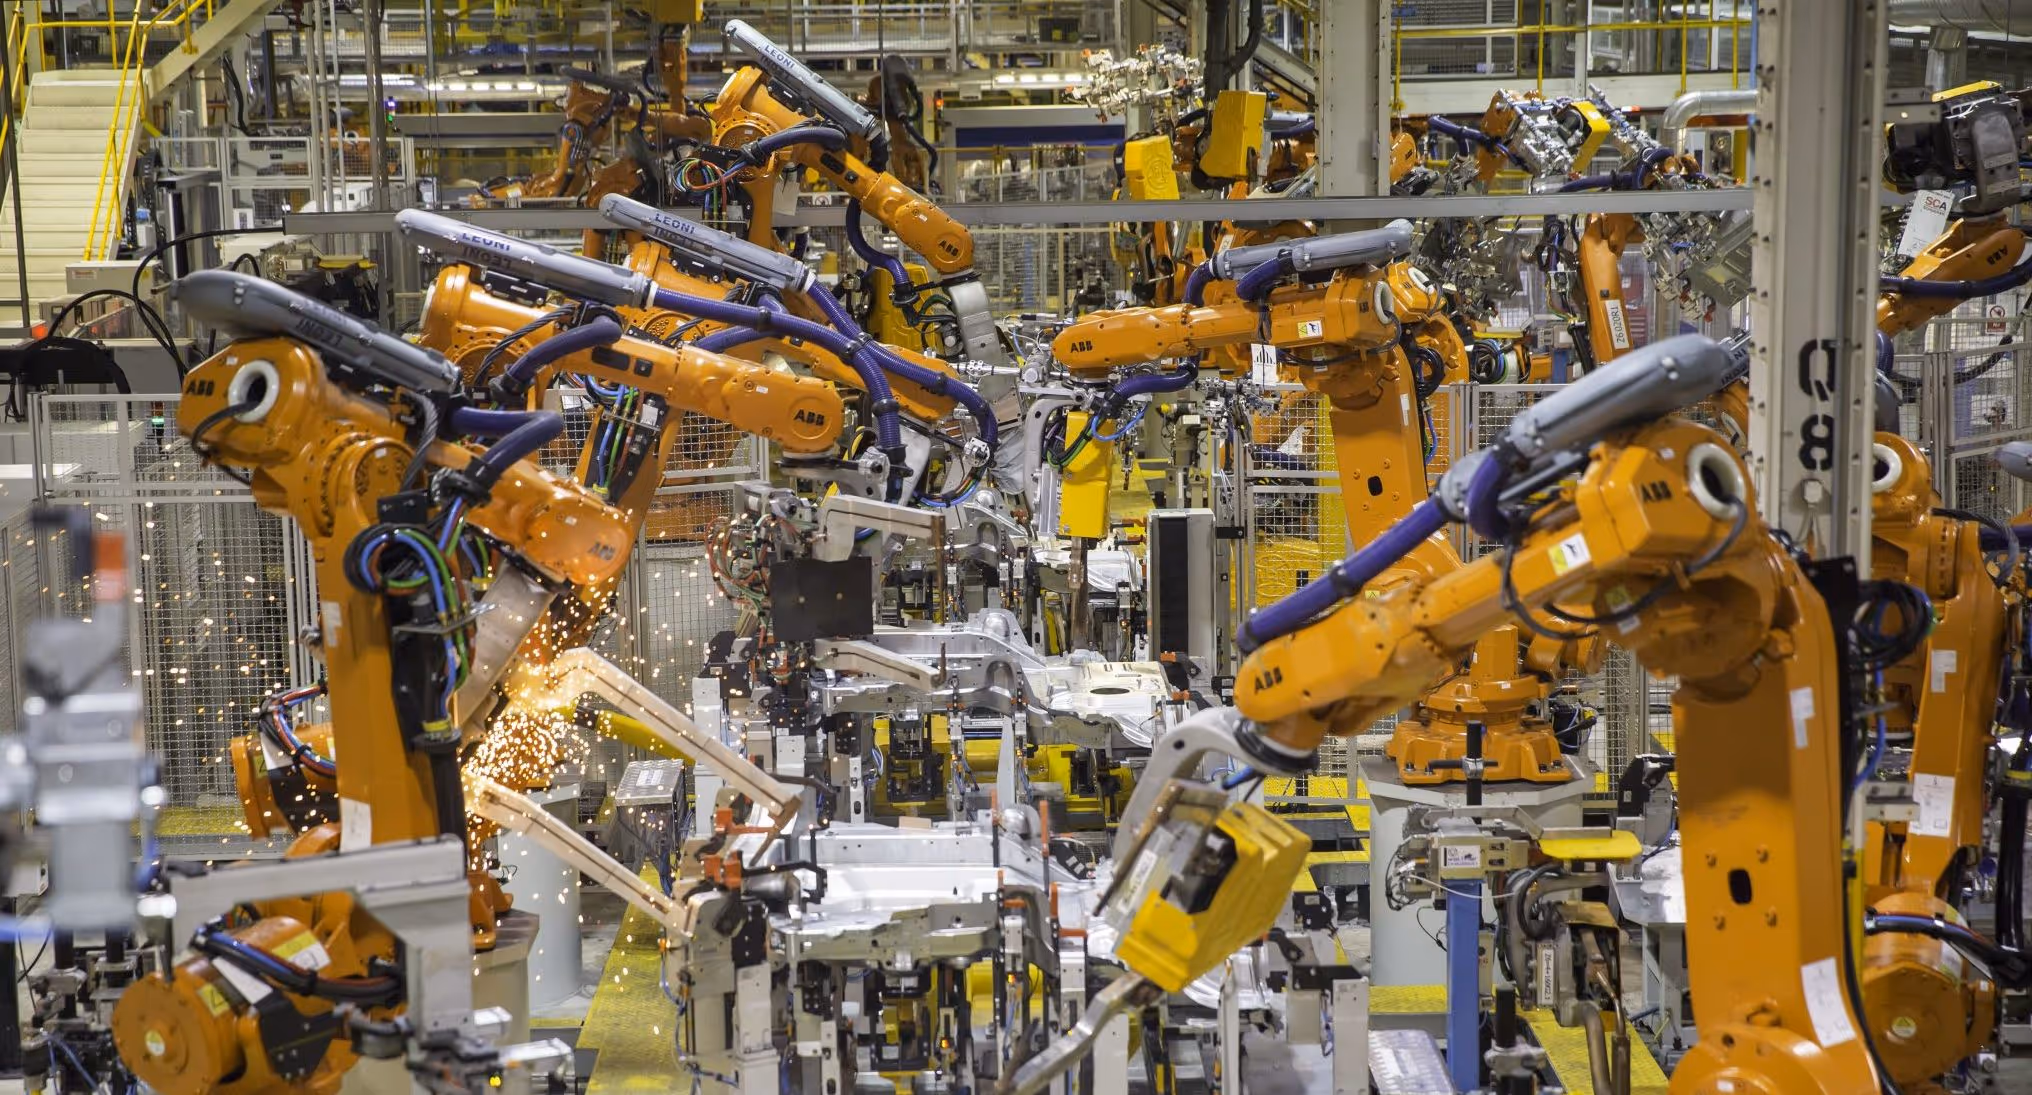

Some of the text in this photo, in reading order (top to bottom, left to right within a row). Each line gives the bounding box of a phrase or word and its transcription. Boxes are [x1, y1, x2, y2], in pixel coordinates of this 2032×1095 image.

[764, 44, 795, 69] LEONI
[1925, 196, 1947, 211] SCA
[655, 213, 695, 235] LEONI
[938, 240, 959, 257] ABB
[1070, 340, 1093, 353] ABB
[185, 380, 215, 397] ABB
[793, 409, 825, 427] ABB
[1641, 480, 1673, 503] ABB
[1254, 666, 1283, 695] ABB
